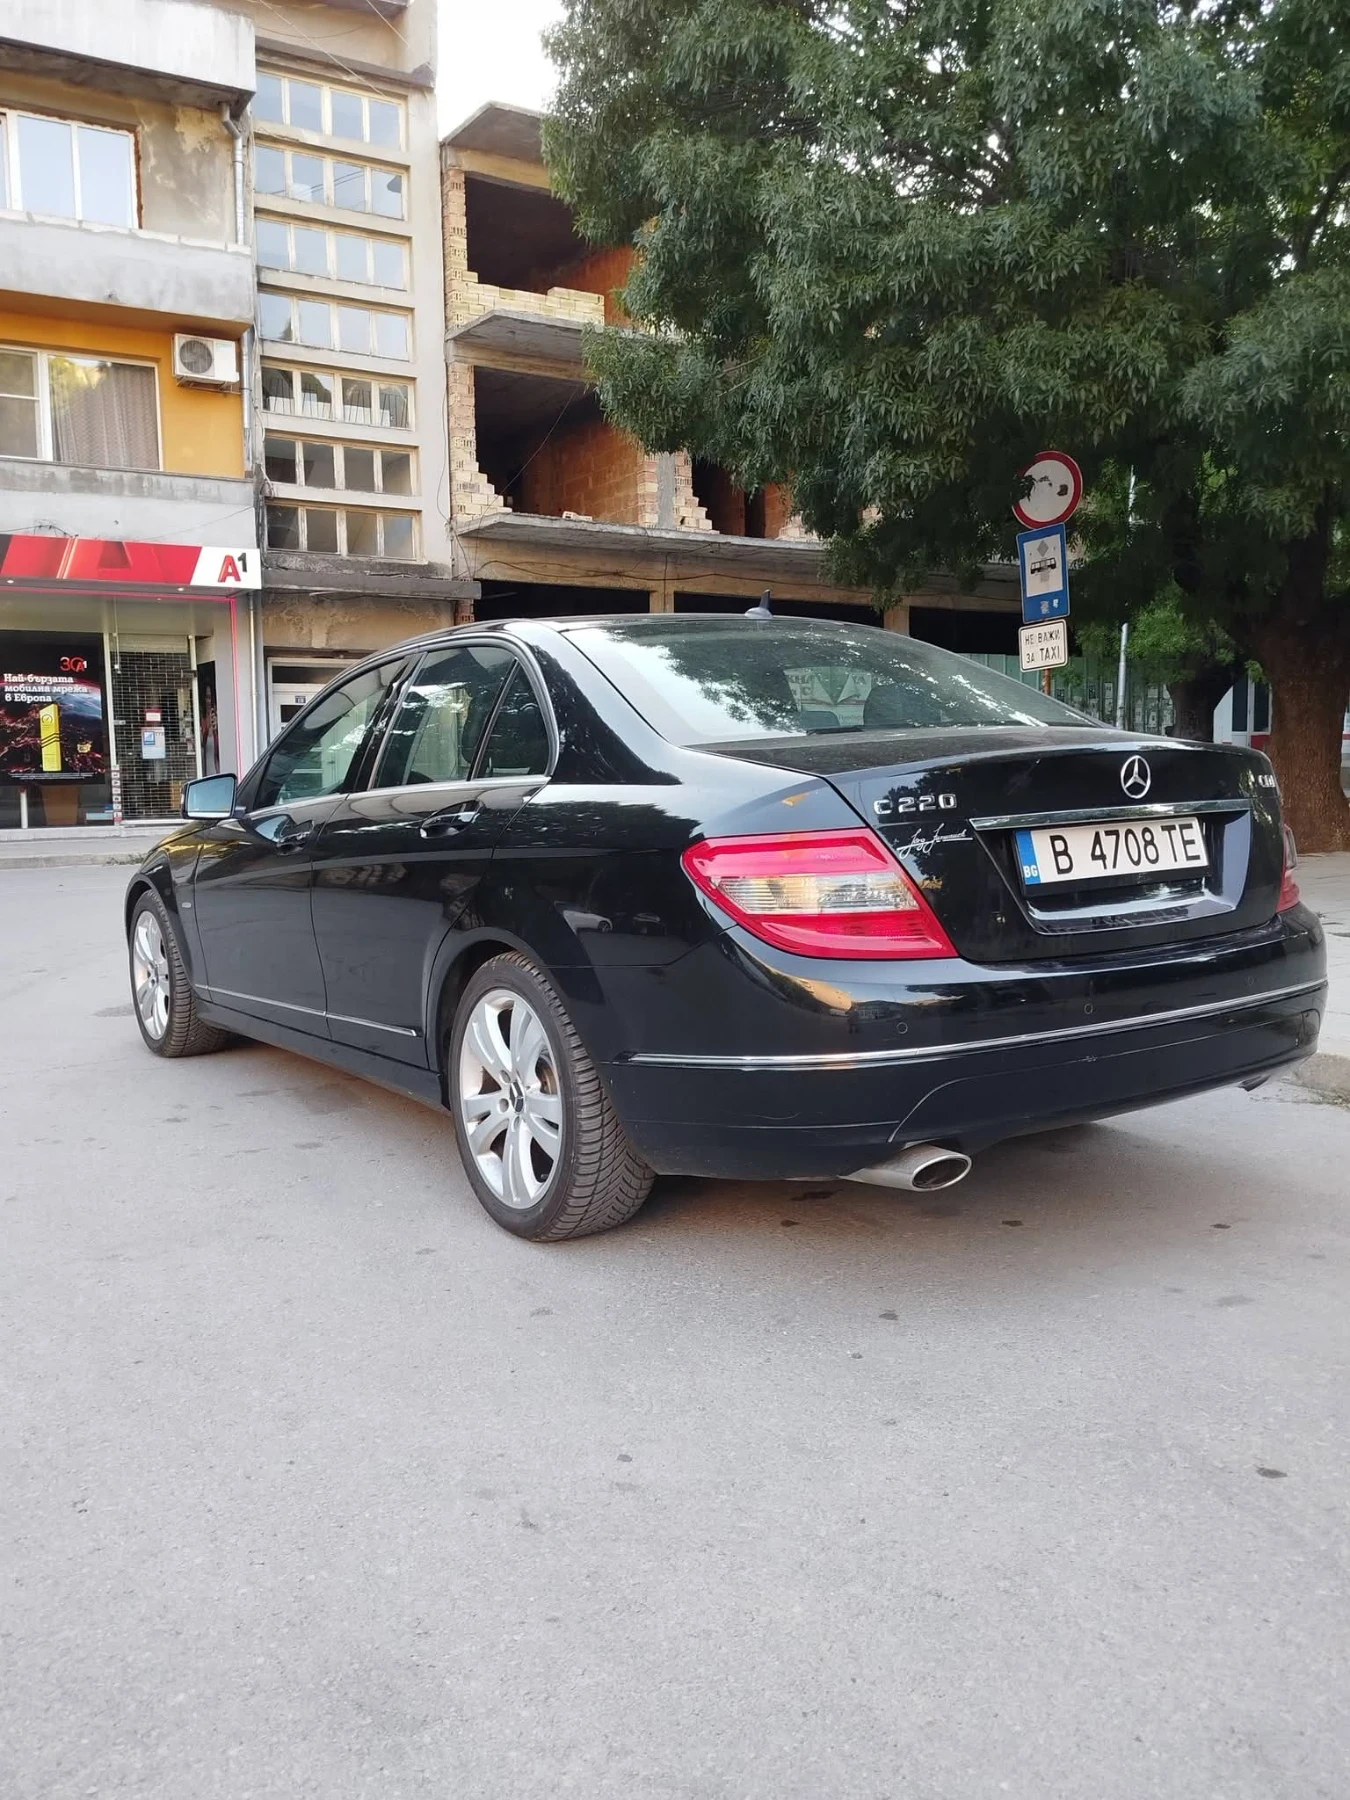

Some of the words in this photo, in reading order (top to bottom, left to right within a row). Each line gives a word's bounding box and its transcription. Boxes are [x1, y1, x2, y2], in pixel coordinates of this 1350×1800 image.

[217, 552, 247, 583] A1
[1025, 633, 1035, 645] НЕ
[1038, 629, 1060, 643] ВАЖИ
[1026, 652, 1035, 664] ЗА
[1039, 645, 1061, 661] TAXI
[3, 673, 74, 685] Най-бързата
[4, 684, 51, 692] мобилна
[52, 685, 88, 694] мрежа
[4, 693, 12, 702] в
[13, 693, 53, 703] Европа
[898, 793, 957, 813] 220
[1049, 834, 1074, 875] B
[1091, 827, 1159, 869] 4708
[1160, 823, 1201, 862] TE
[1023, 864, 1039, 879] BG
